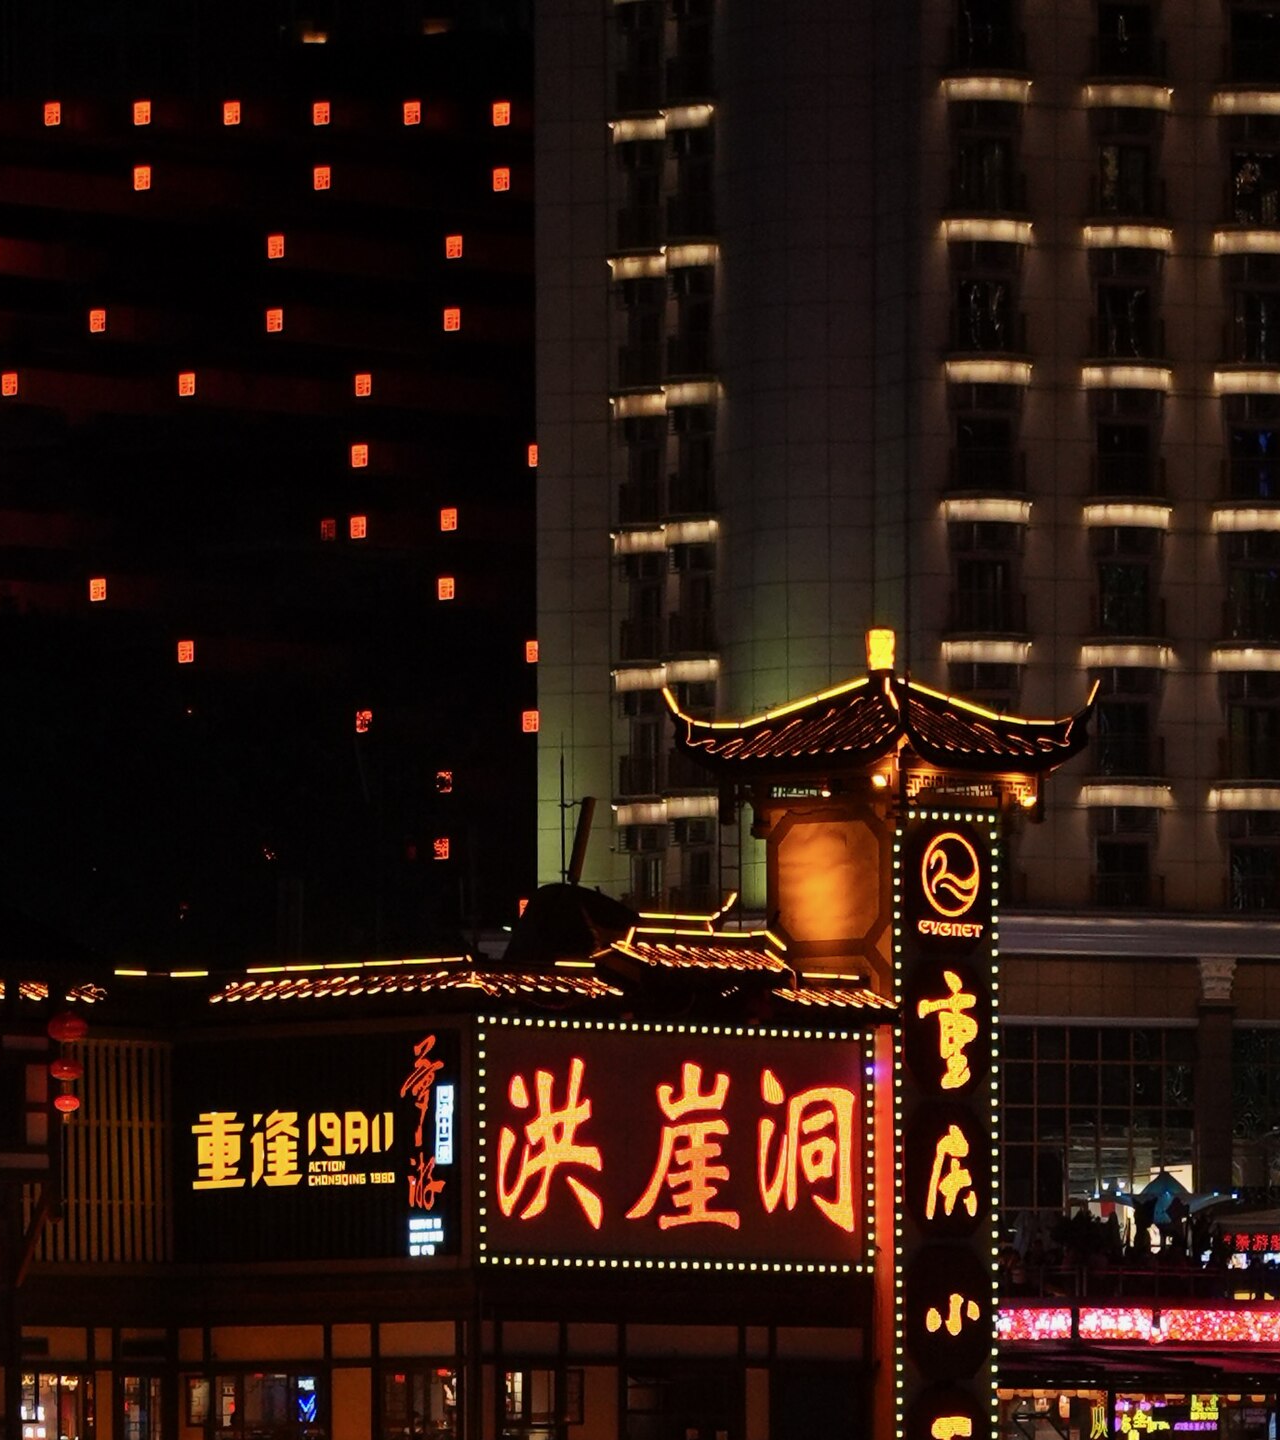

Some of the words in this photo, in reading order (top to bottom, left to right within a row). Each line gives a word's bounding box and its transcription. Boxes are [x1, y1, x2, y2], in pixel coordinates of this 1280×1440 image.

[918, 919, 984, 939] CYGNET
[191, 1110, 303, 1190] 重逢
[308, 1161, 346, 1173] ACTION
[497, 1057, 857, 1233] 洪崖洞
